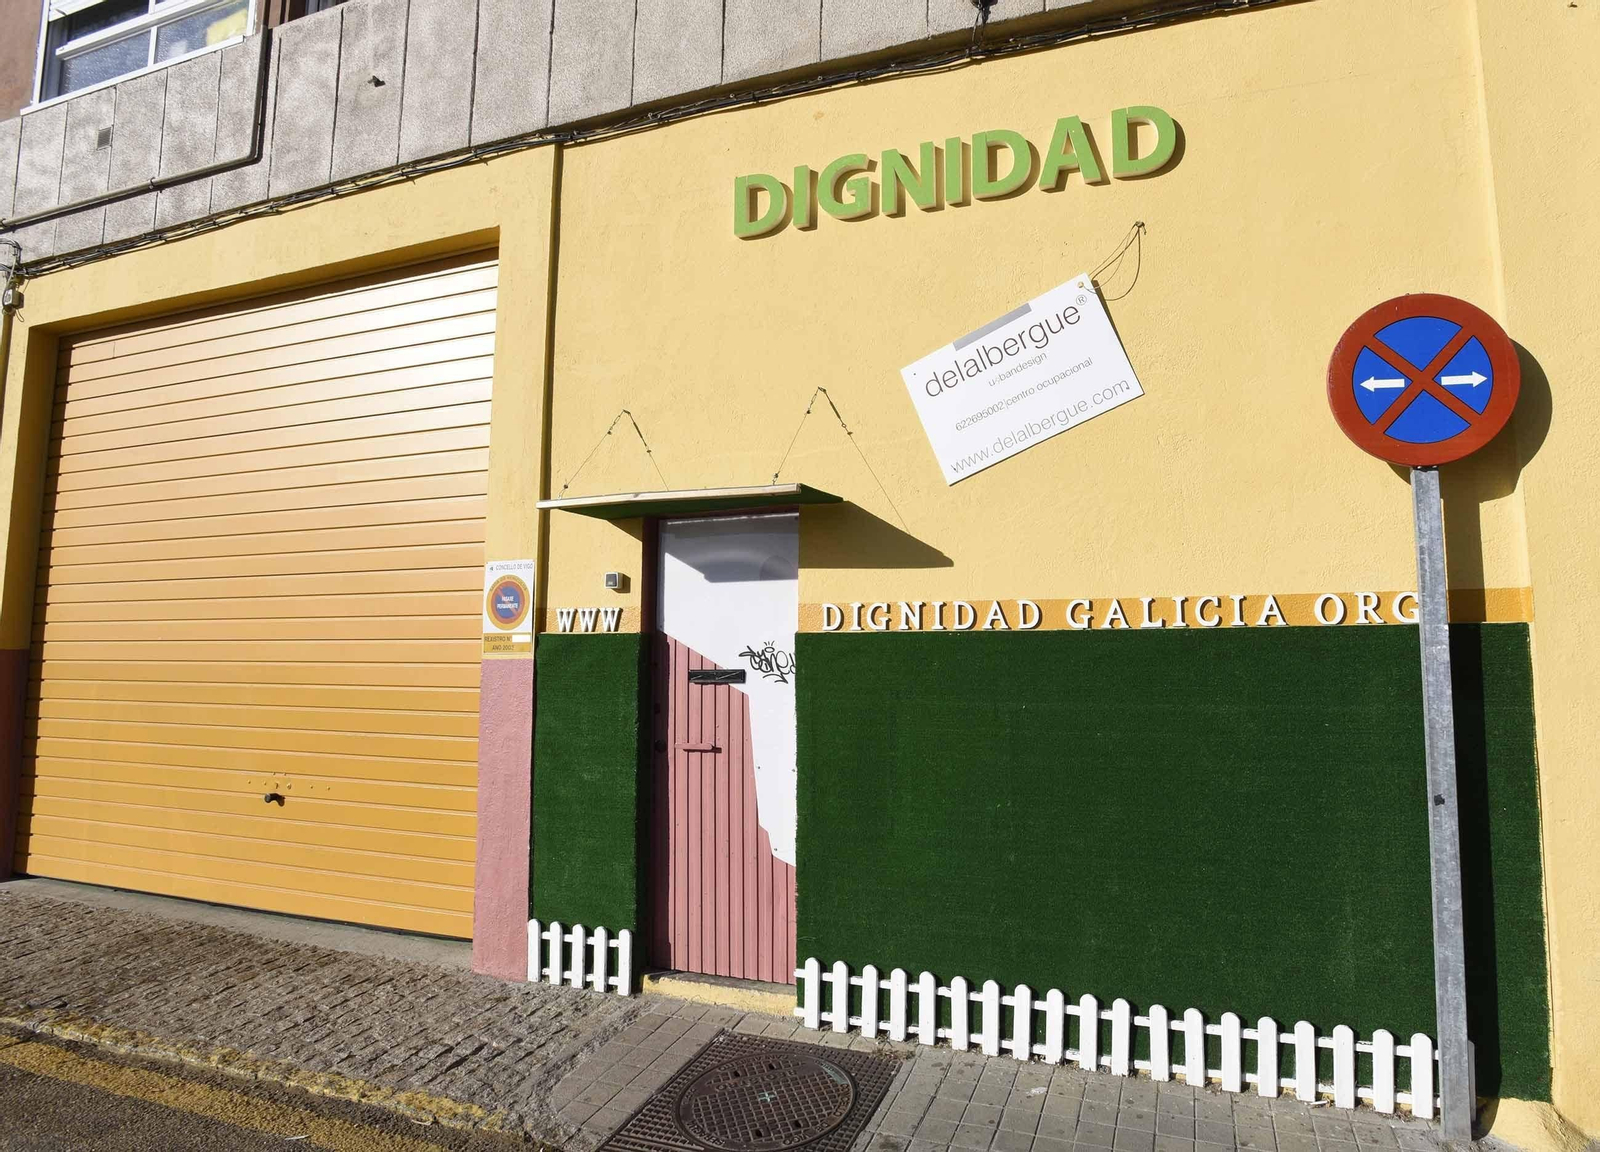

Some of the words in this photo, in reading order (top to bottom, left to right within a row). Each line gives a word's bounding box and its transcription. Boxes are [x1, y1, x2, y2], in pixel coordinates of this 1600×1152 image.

[734, 105, 1177, 239] DIGNIDAD
[989, 352, 1047, 387] ubandesign
[1037, 357, 1093, 391] ocupacional
[951, 378, 1130, 474] www.delalbergue.com
[556, 607, 621, 632] WWW
[822, 598, 1040, 632] DIGNIDAD
[1066, 594, 1287, 630] GALICIA
[1314, 590, 1420, 626] ORG
